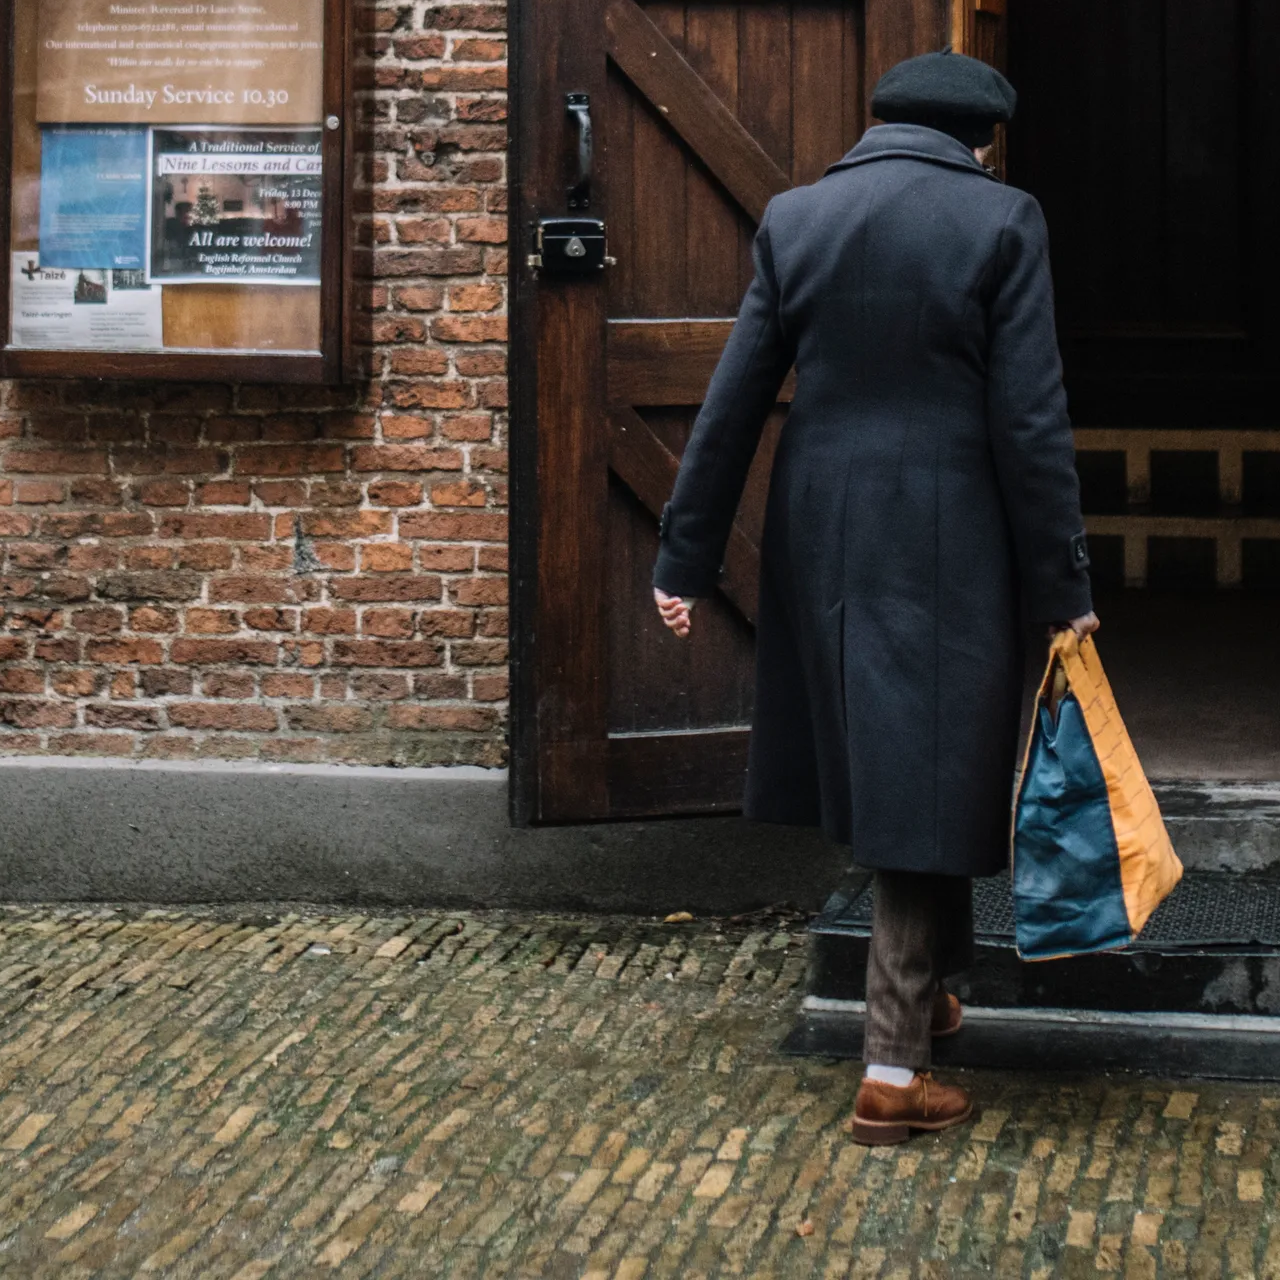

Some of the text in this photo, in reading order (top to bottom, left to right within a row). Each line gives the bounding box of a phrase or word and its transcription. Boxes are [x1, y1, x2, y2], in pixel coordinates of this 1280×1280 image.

[83, 83, 289, 109] Sunday Service 10.30
[189, 141, 321, 154] A Traditional Service of
[164, 157, 198, 171] Nine
[201, 157, 260, 172] Lessons
[263, 157, 291, 172] and
[259, 188, 289, 199] Friday,
[291, 189, 301, 198] 13
[303, 200, 318, 209] PM
[188, 231, 313, 248] All are welcome!
[198, 253, 303, 264] English Reformed Church
[248, 265, 297, 274] Amsterdam
